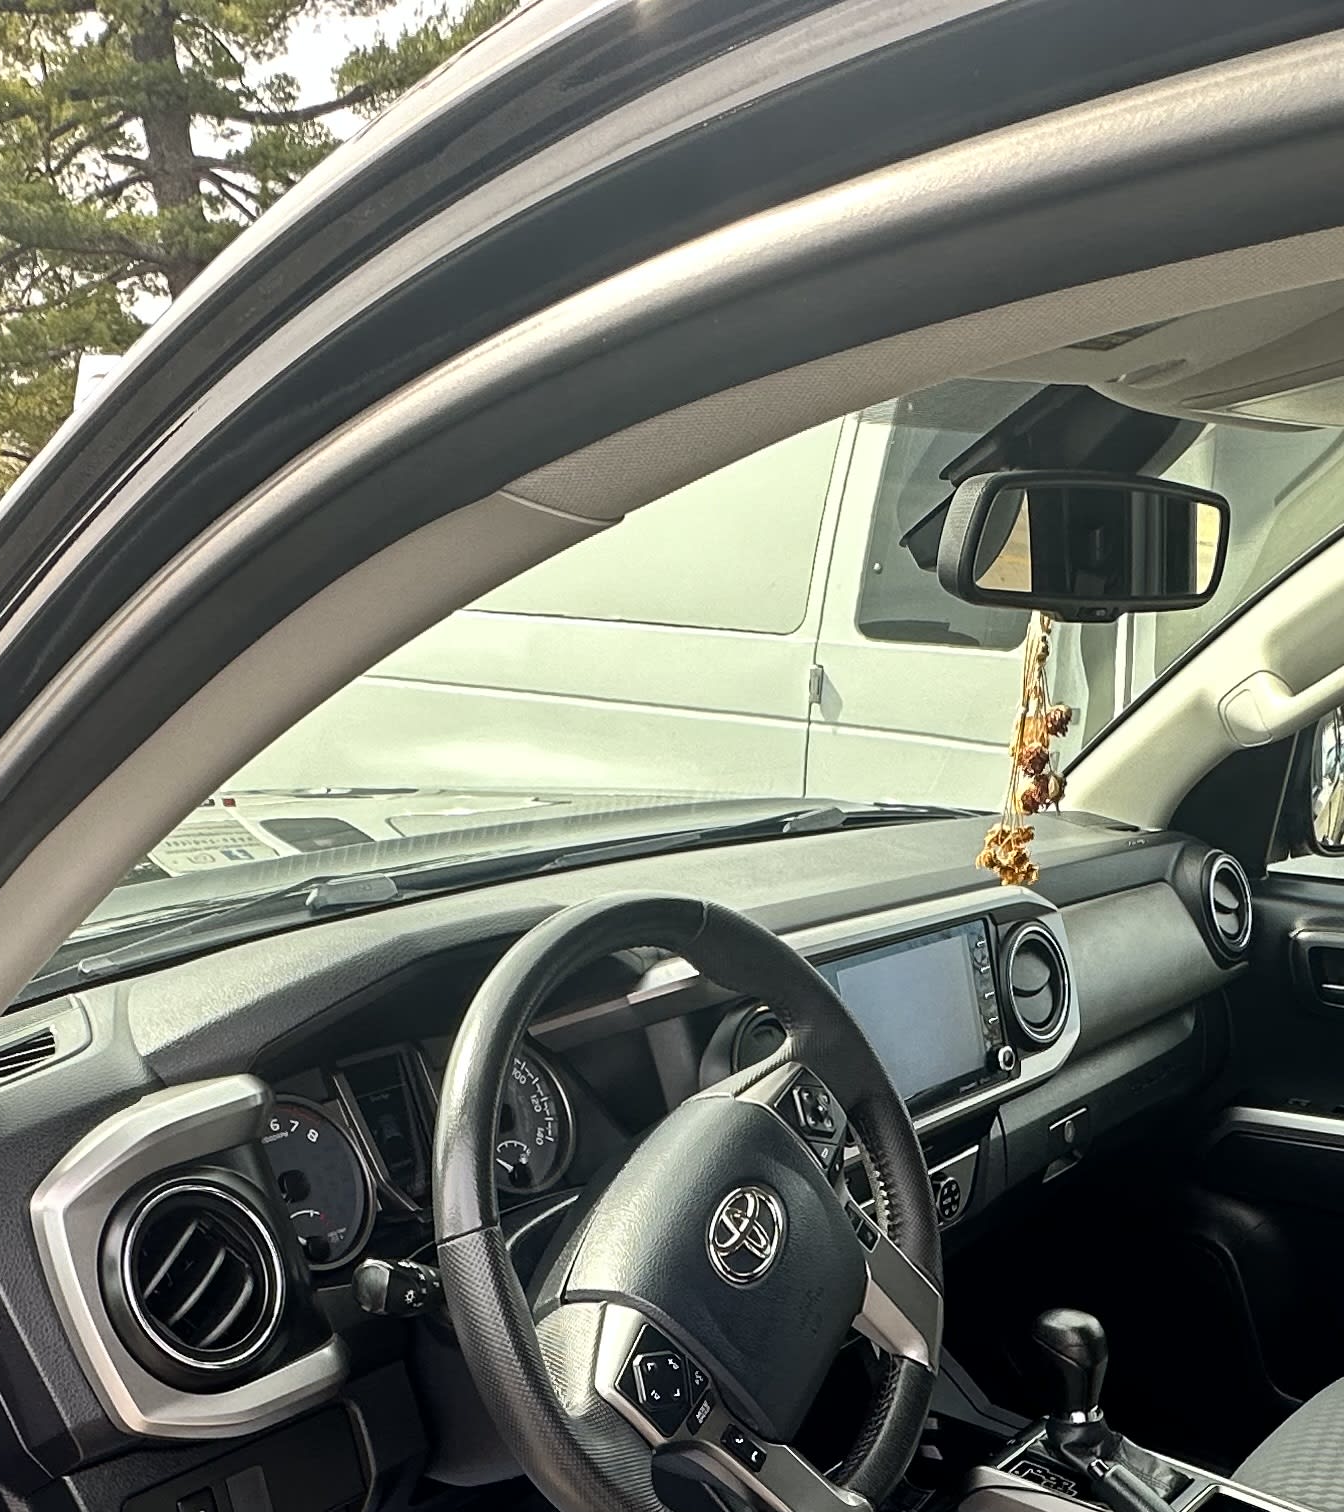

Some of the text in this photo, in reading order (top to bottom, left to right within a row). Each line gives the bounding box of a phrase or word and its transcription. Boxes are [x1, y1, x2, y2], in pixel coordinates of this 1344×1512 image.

[512, 1067, 527, 1085] 100
[530, 1094, 542, 1113] 120
[269, 1118, 320, 1143] 6 7 8
[535, 1127, 545, 1146] 140
